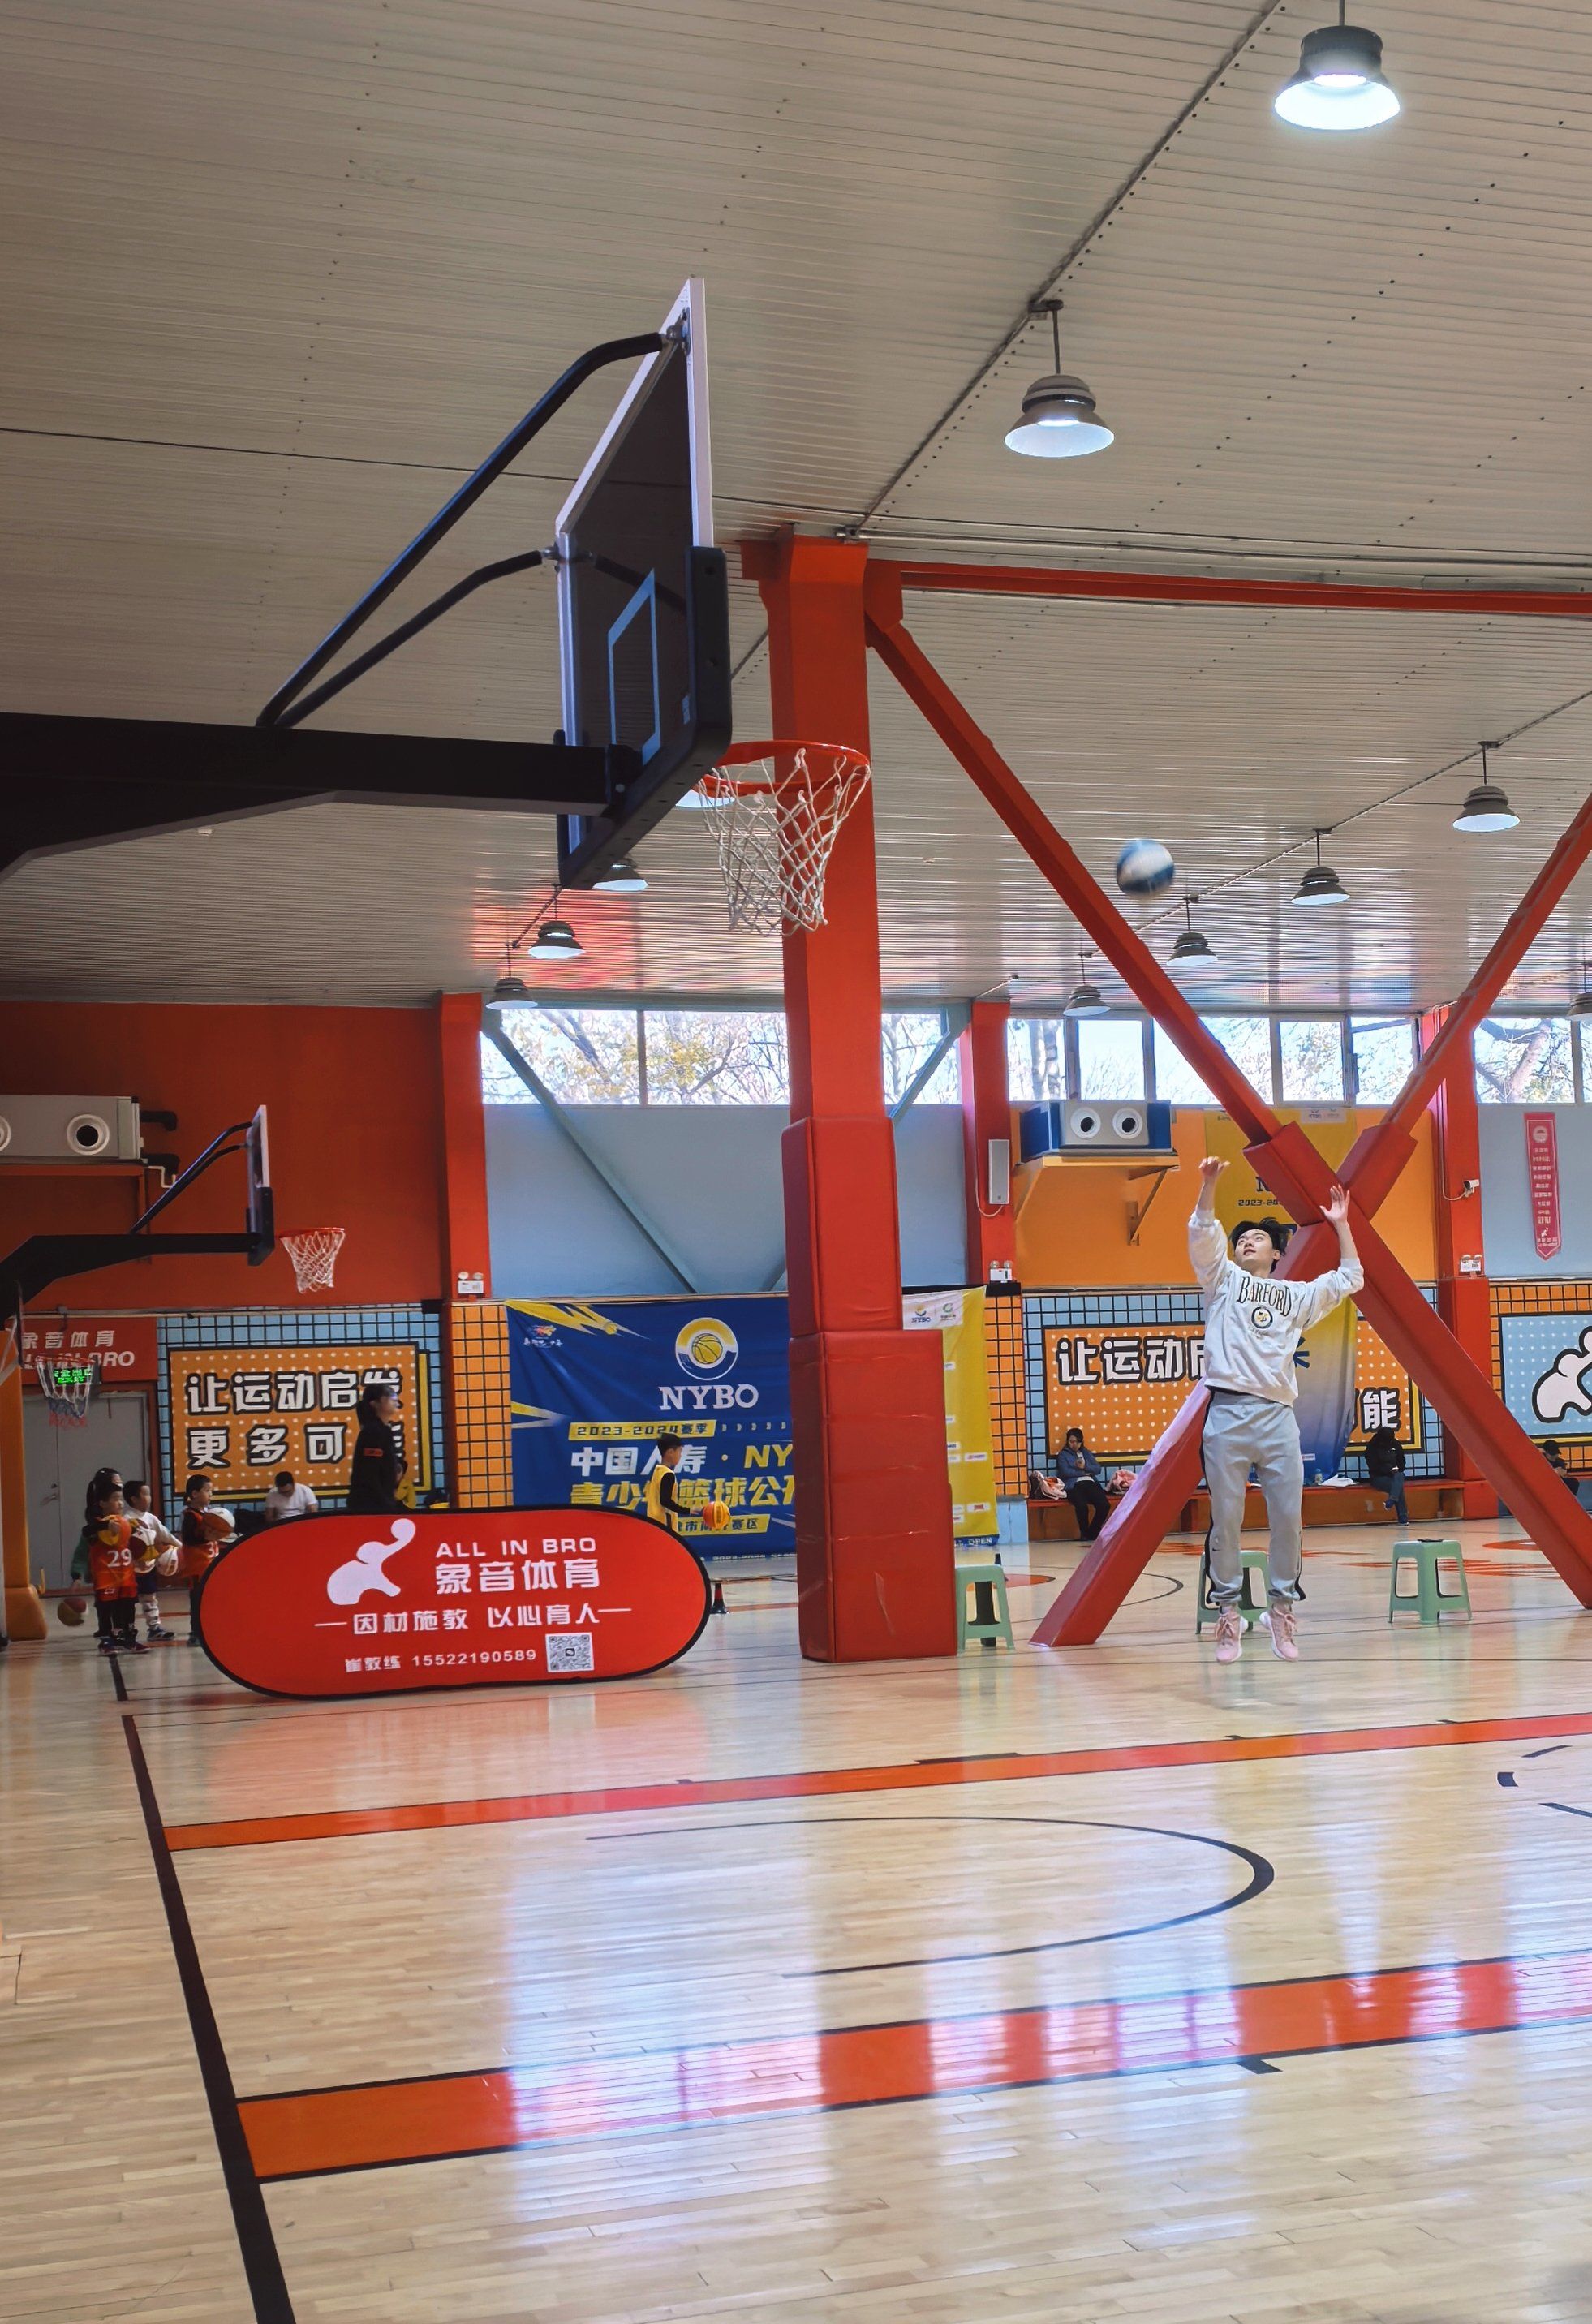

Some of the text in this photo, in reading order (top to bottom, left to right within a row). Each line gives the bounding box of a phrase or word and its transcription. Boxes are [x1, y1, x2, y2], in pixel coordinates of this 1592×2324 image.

[1236, 1276, 1292, 1317] BARFORD
[659, 1384, 759, 1411] NYBO
[189, 1424, 402, 1467] 更多可
[570, 1474, 795, 1511] 青少篮球公
[107, 1548, 133, 1568] 29
[436, 1537, 596, 1558] ALL IN BRO
[435, 1558, 600, 1595] 象音体育
[354, 1603, 600, 1635] 因材施教 以心育人
[411, 1649, 537, 1668] 15522190589
